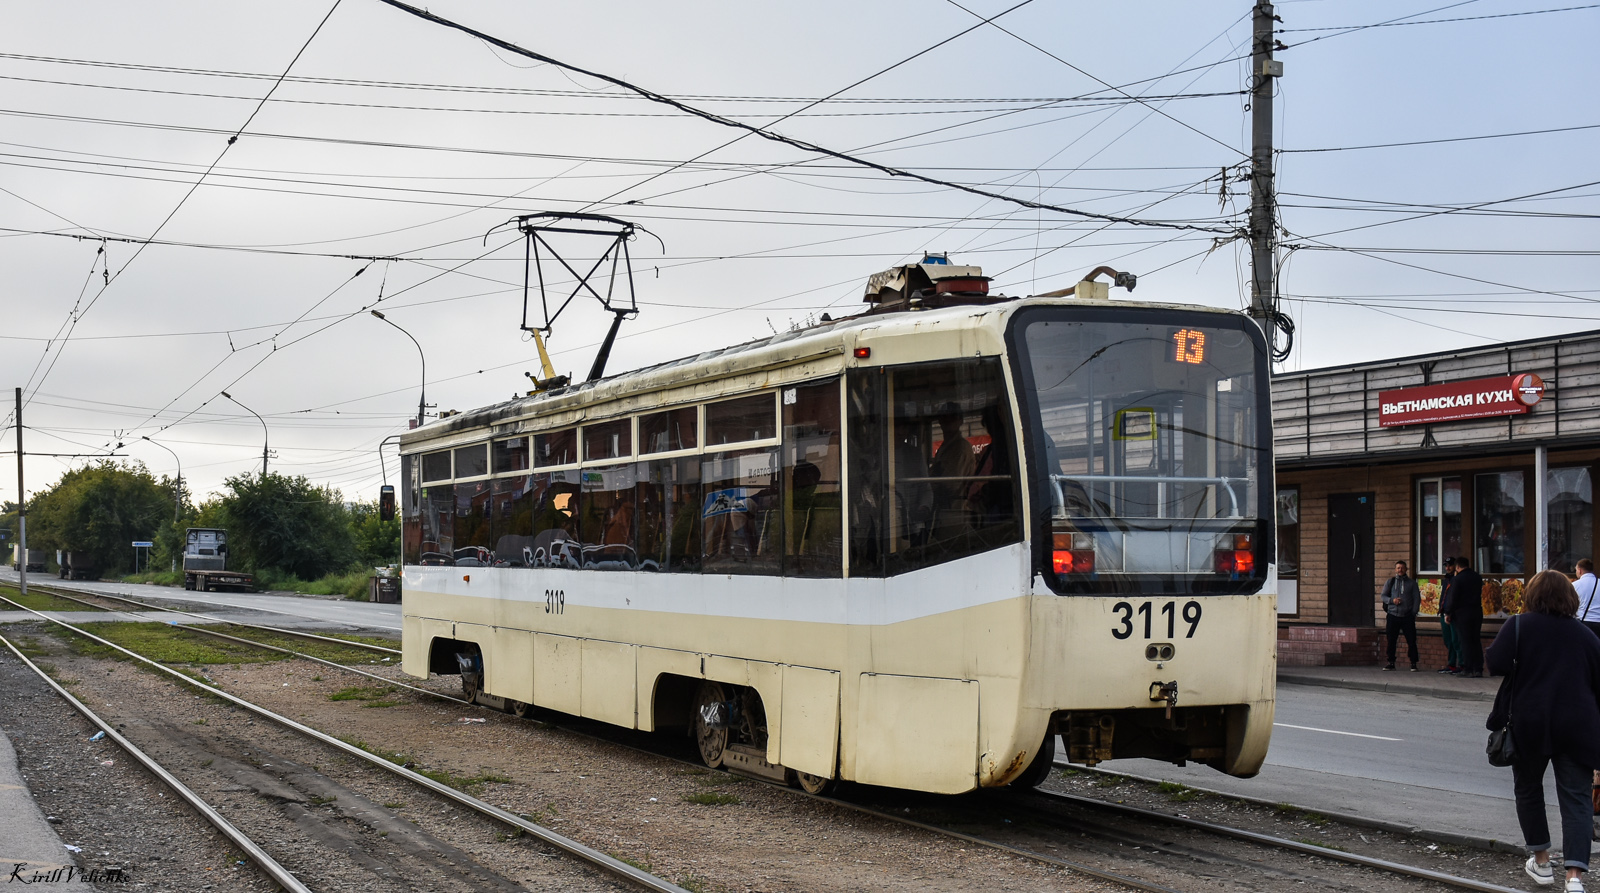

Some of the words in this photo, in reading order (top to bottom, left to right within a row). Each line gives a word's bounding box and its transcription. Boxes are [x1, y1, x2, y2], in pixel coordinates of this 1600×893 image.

[1173, 328, 1205, 364] 13
[1382, 394, 1473, 415] ВЬЕТНАМСКАЯ
[1476, 389, 1515, 405] КУХН
[544, 589, 565, 615] 3119
[1111, 600, 1203, 640] 3119
